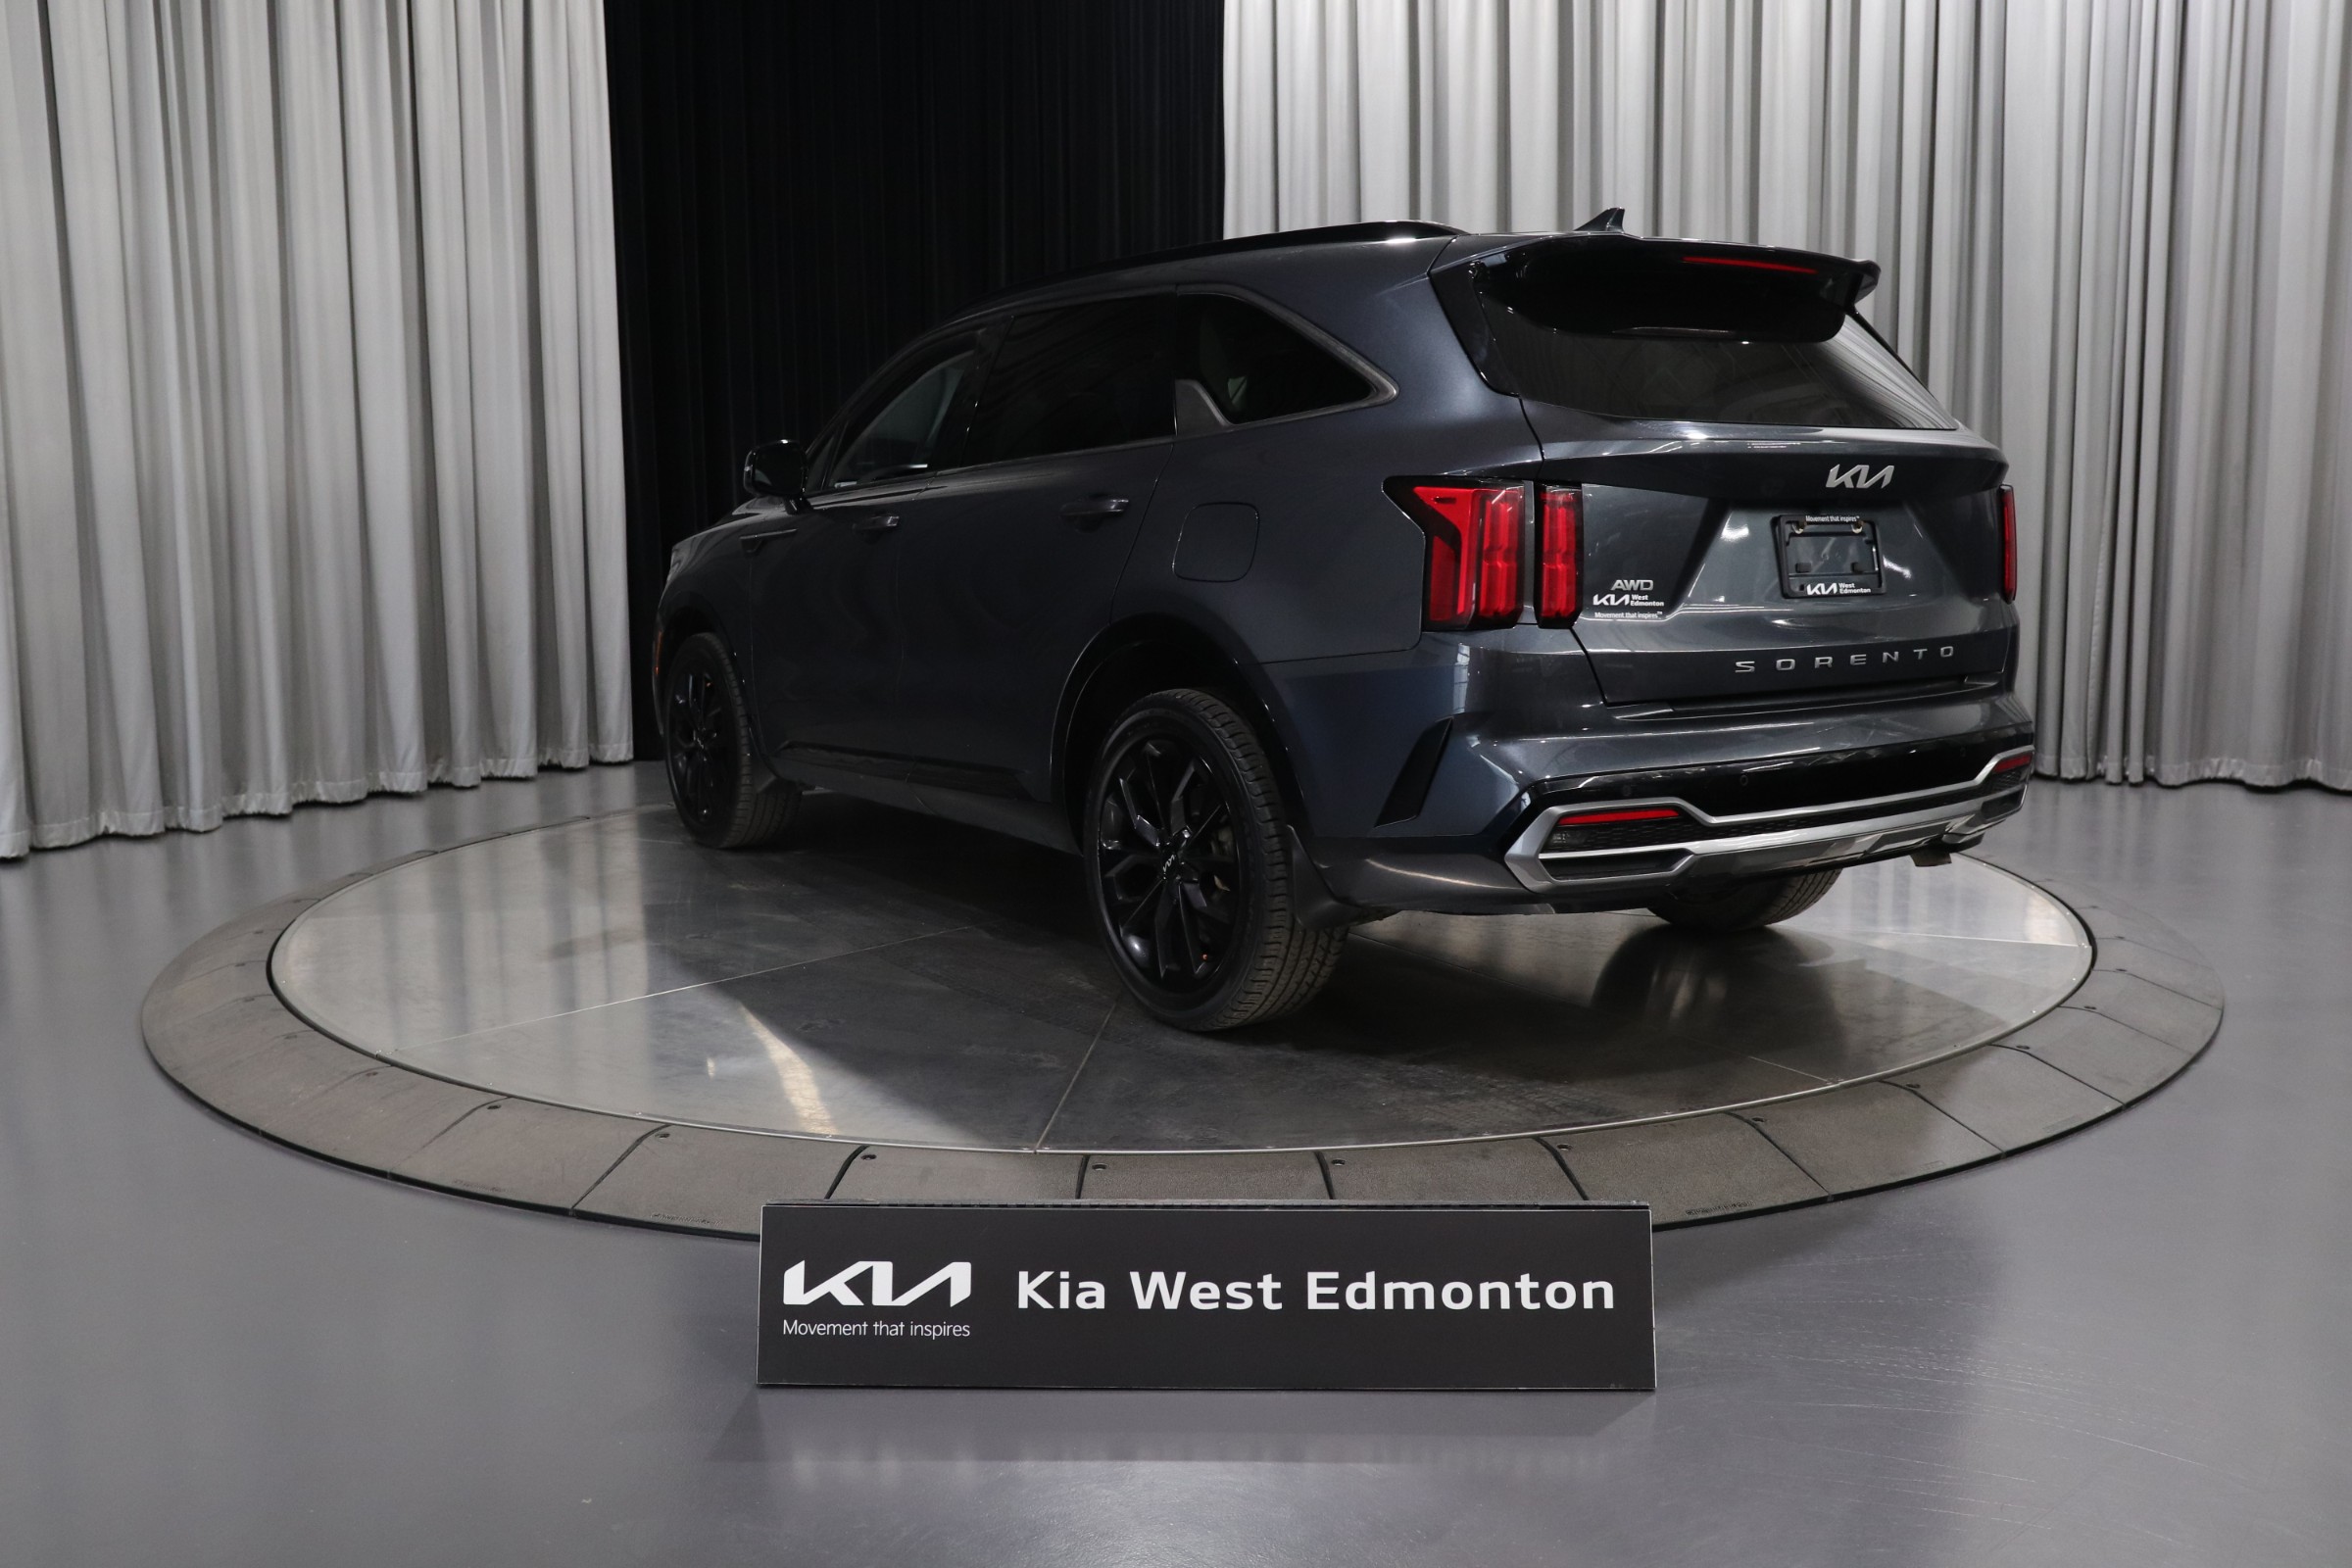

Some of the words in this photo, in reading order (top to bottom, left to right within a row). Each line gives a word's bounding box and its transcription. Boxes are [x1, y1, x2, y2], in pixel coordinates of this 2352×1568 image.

[1826, 464, 1894, 489] KIA
[1610, 579, 1654, 591] AWD
[1806, 582, 1838, 596] KIA
[1592, 593, 1630, 606] KIA
[1735, 645, 1954, 673] SORENTO
[783, 1260, 971, 1307] KIA
[1017, 1270, 1105, 1309] Kia
[1129, 1270, 1283, 1311] West
[1306, 1270, 1615, 1311] Edmonton
[783, 1319, 868, 1336] Movement
[873, 1320, 905, 1336] that
[910, 1321, 970, 1340] inspires
